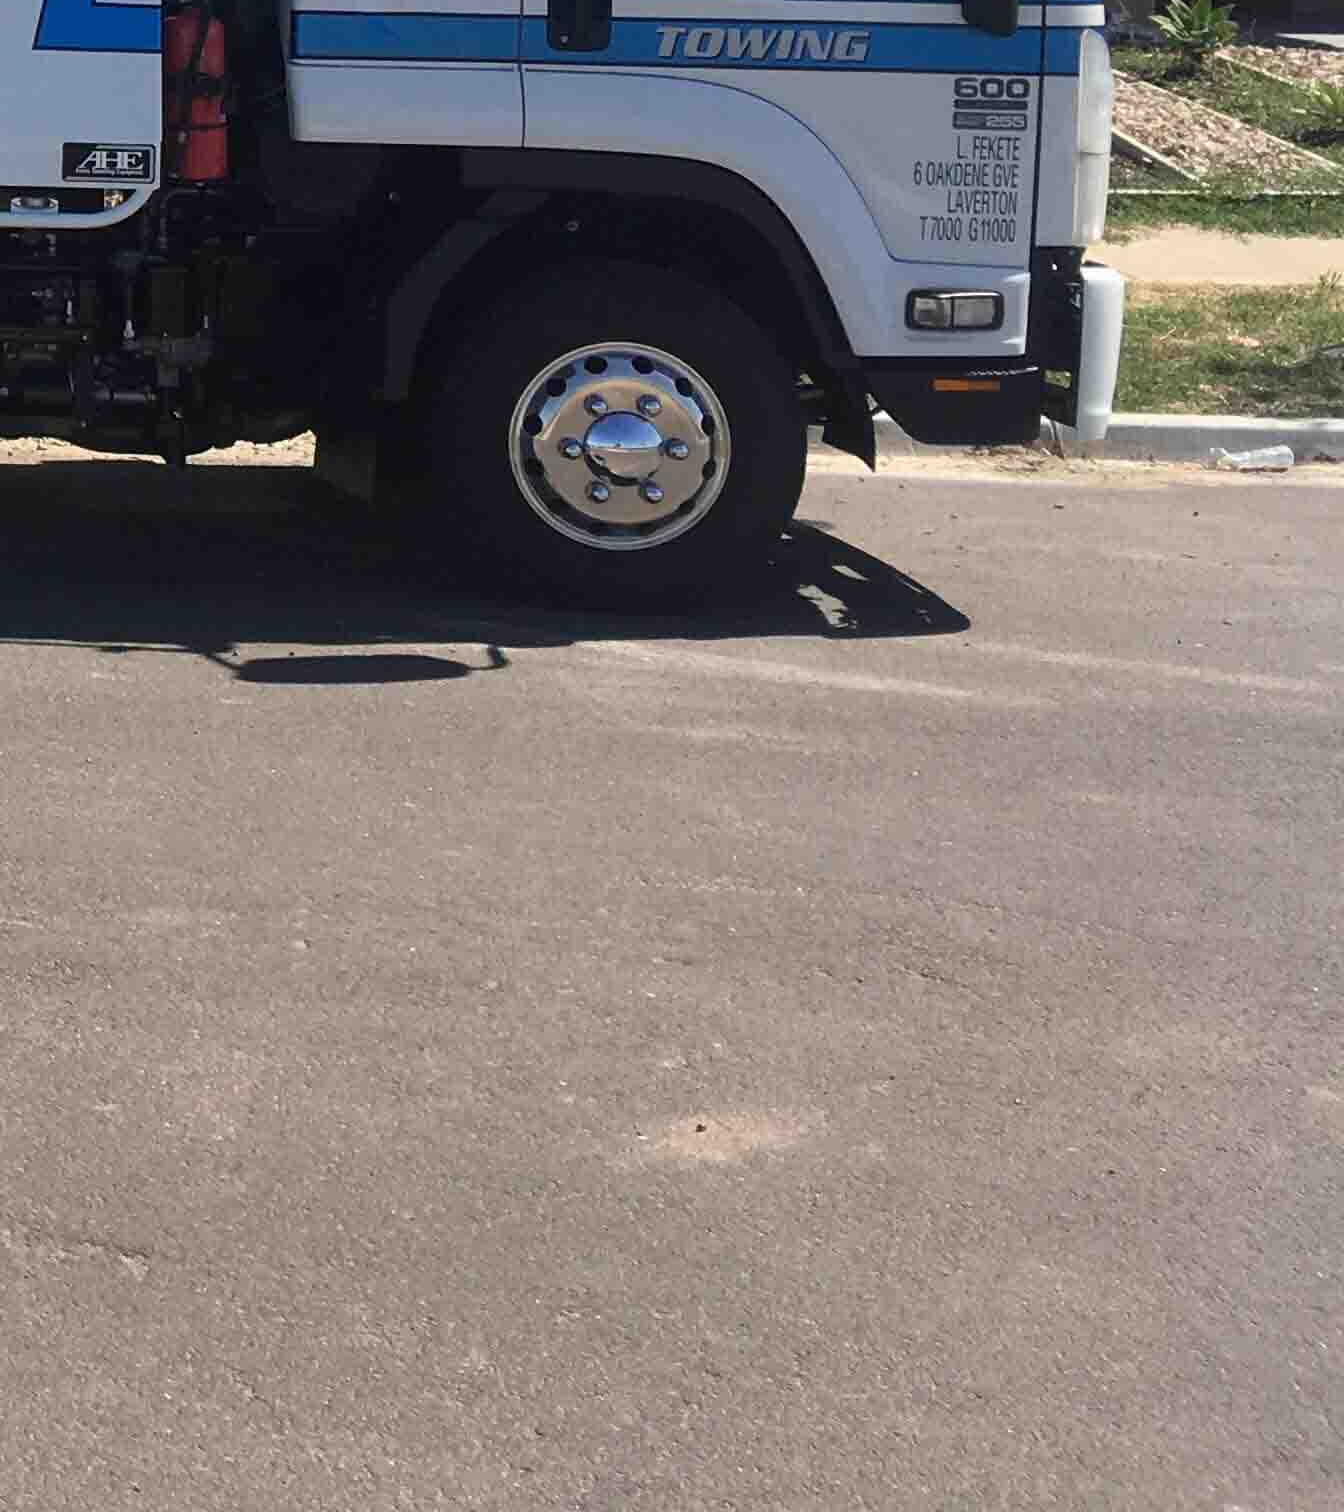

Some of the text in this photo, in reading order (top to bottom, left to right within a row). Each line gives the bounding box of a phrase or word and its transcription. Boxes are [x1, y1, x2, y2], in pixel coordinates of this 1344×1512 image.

[656, 27, 870, 63] TOWING
[954, 78, 1030, 98] 600
[79, 150, 144, 170] AHE
[972, 136, 1021, 161] FEKETE
[913, 161, 1019, 189] 6 OAKDENE GVE
[947, 189, 1018, 215] LAVERTON
